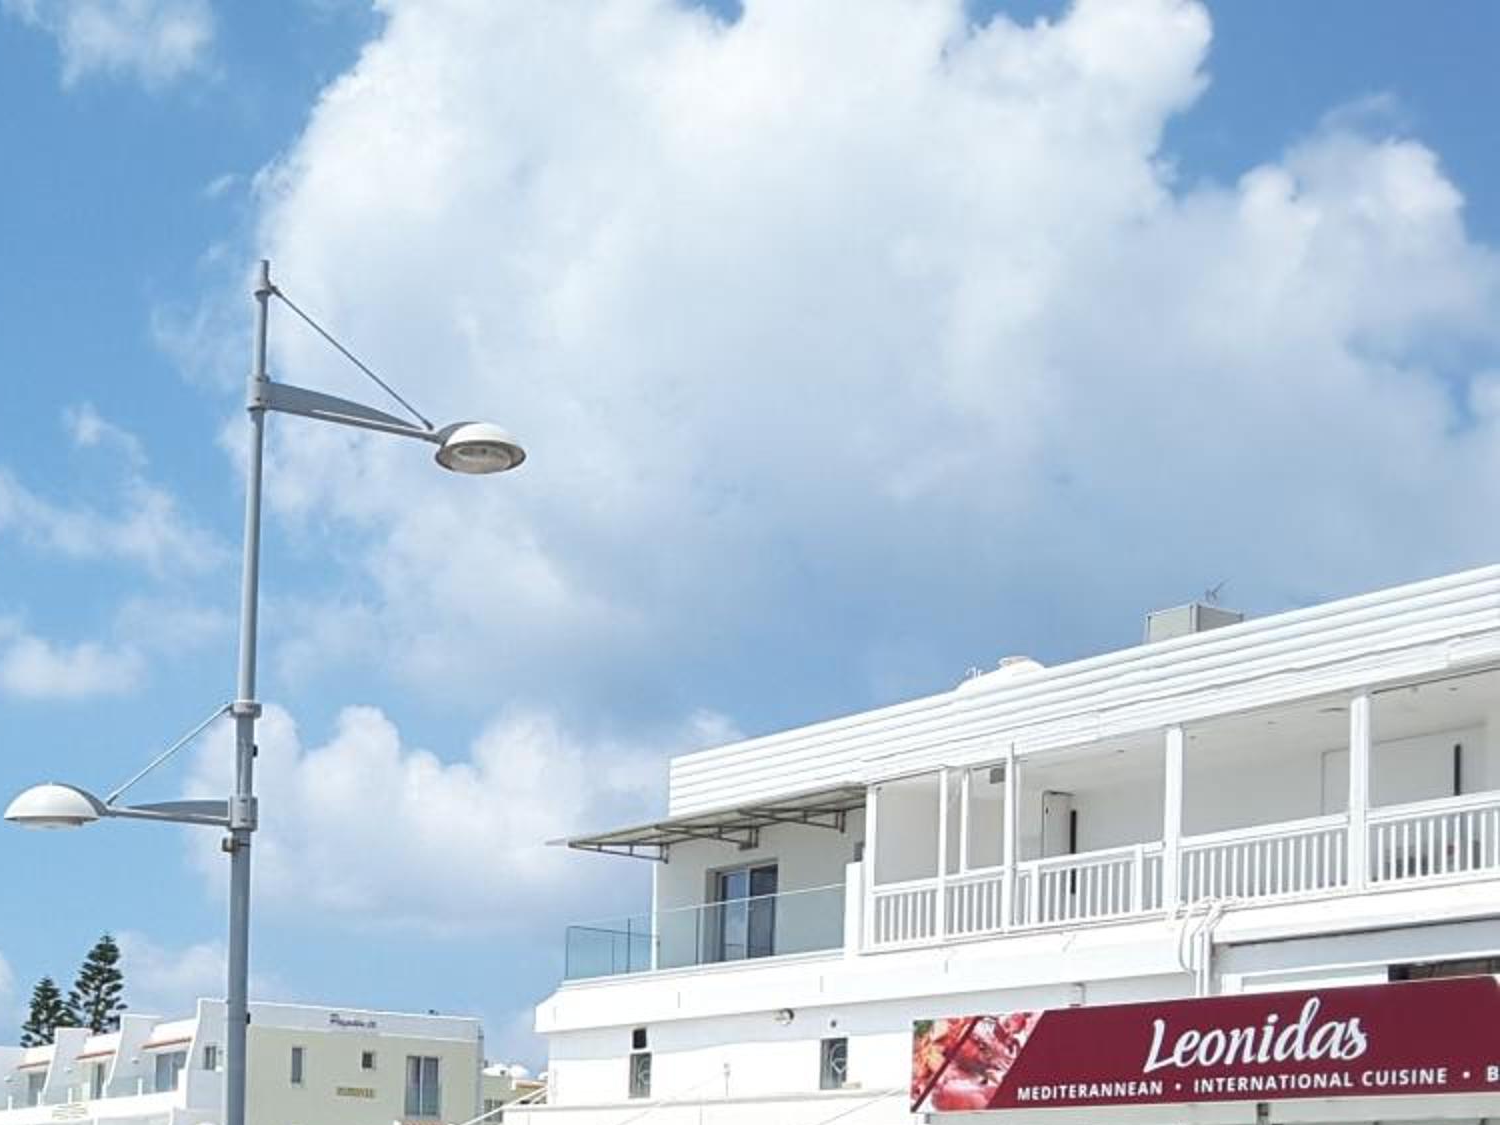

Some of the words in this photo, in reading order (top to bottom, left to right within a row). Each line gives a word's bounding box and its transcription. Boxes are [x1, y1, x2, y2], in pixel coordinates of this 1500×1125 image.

[1143, 996, 1368, 1073] Leonidas
[1017, 1080, 1163, 1101] MEDITERANNEAN
[1193, 1071, 1353, 1093] INTERNATIONAL
[1361, 1066, 1448, 1087] CUISINE
